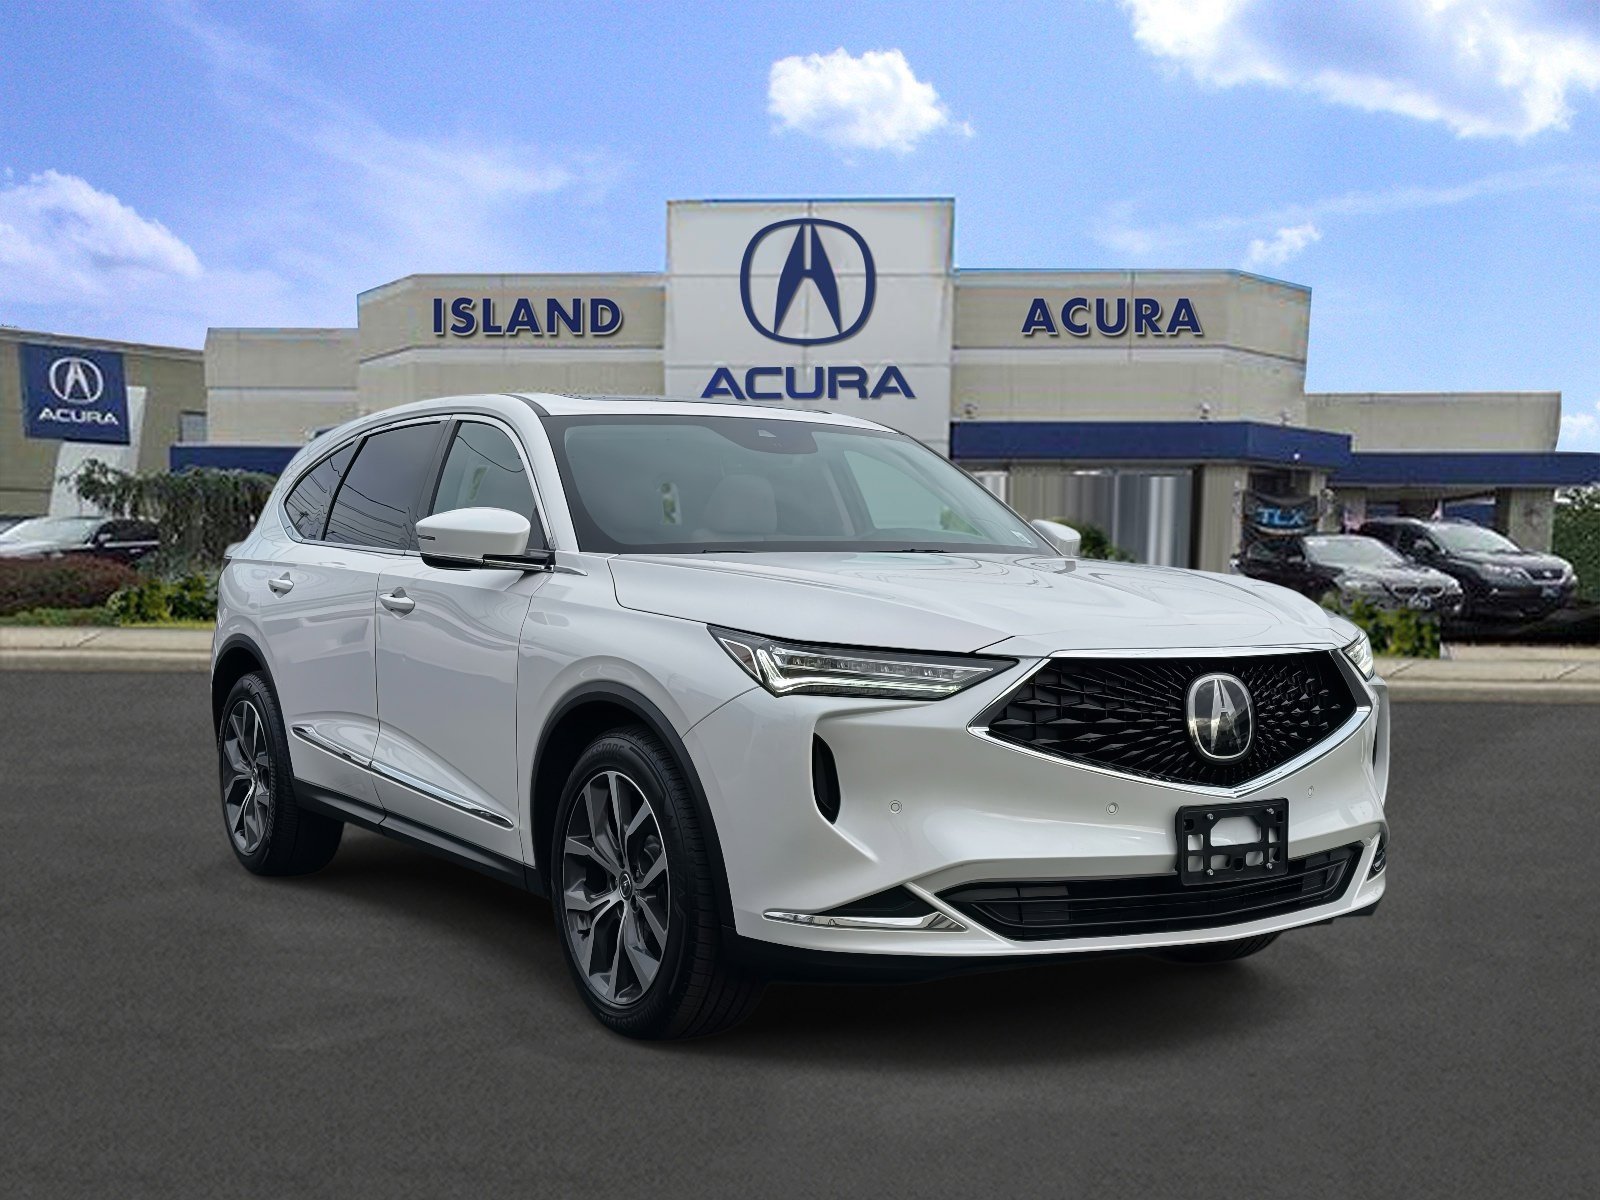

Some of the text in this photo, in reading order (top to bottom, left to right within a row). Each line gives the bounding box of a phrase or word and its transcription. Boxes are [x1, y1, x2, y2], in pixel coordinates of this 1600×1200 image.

[433, 297, 623, 336] ISLAND
[1021, 297, 1203, 336] ACURA
[701, 365, 916, 400] ACURA
[38, 407, 119, 425] ACURA
[1257, 507, 1305, 525] TLX
